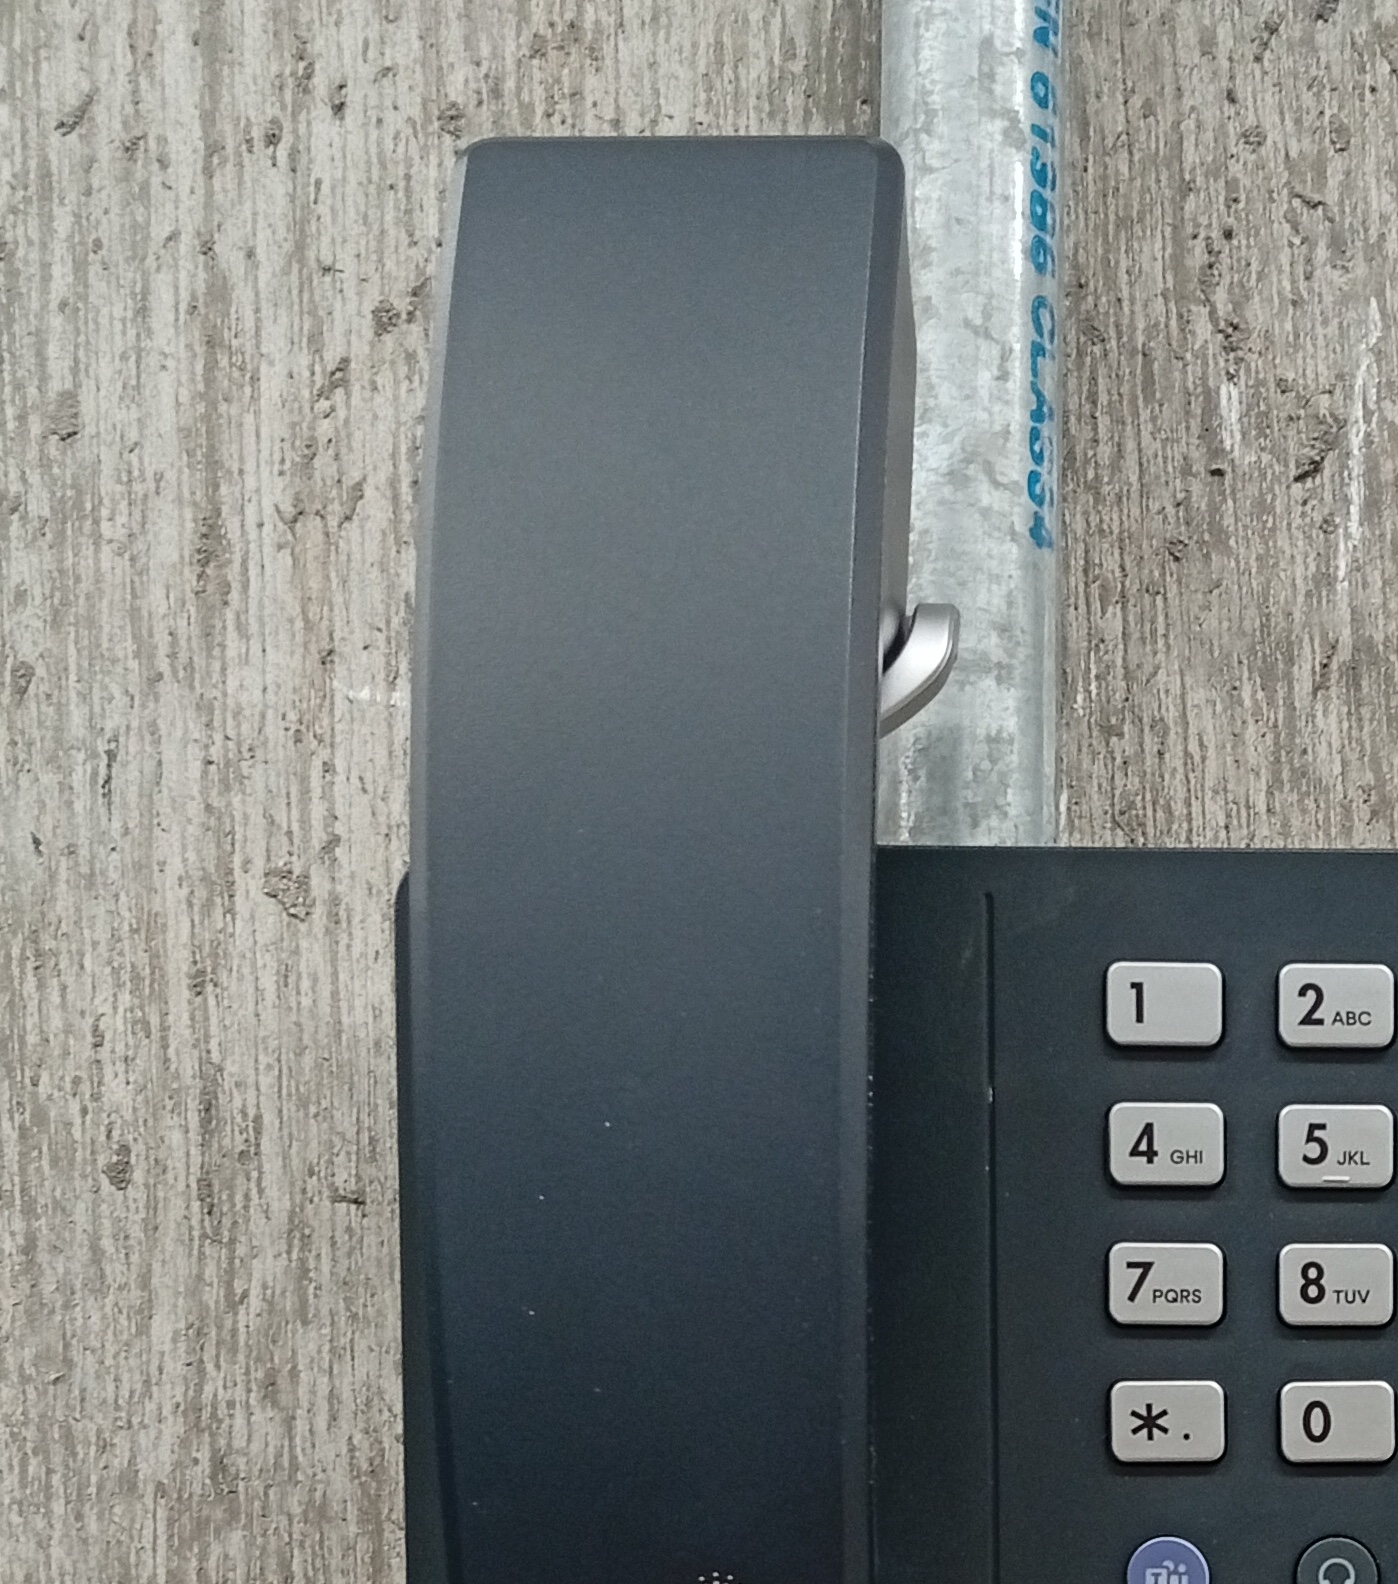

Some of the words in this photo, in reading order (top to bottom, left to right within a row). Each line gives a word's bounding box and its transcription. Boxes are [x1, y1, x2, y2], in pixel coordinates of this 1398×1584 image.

[1130, 982, 1145, 1023] 1
[1297, 983, 1325, 1026] 2
[1332, 1011, 1372, 1026] ABC
[1129, 1123, 1158, 1164] 4
[1170, 1150, 1203, 1165] GHI
[1302, 1123, 1329, 1165] 5
[1337, 1151, 1370, 1166] JKL
[1125, 1262, 1155, 1302] 7
[1152, 1289, 1202, 1304] PQRS
[1299, 1262, 1326, 1304] 8
[1333, 1290, 1370, 1304] TUV
[1303, 1400, 1331, 1443] 0
